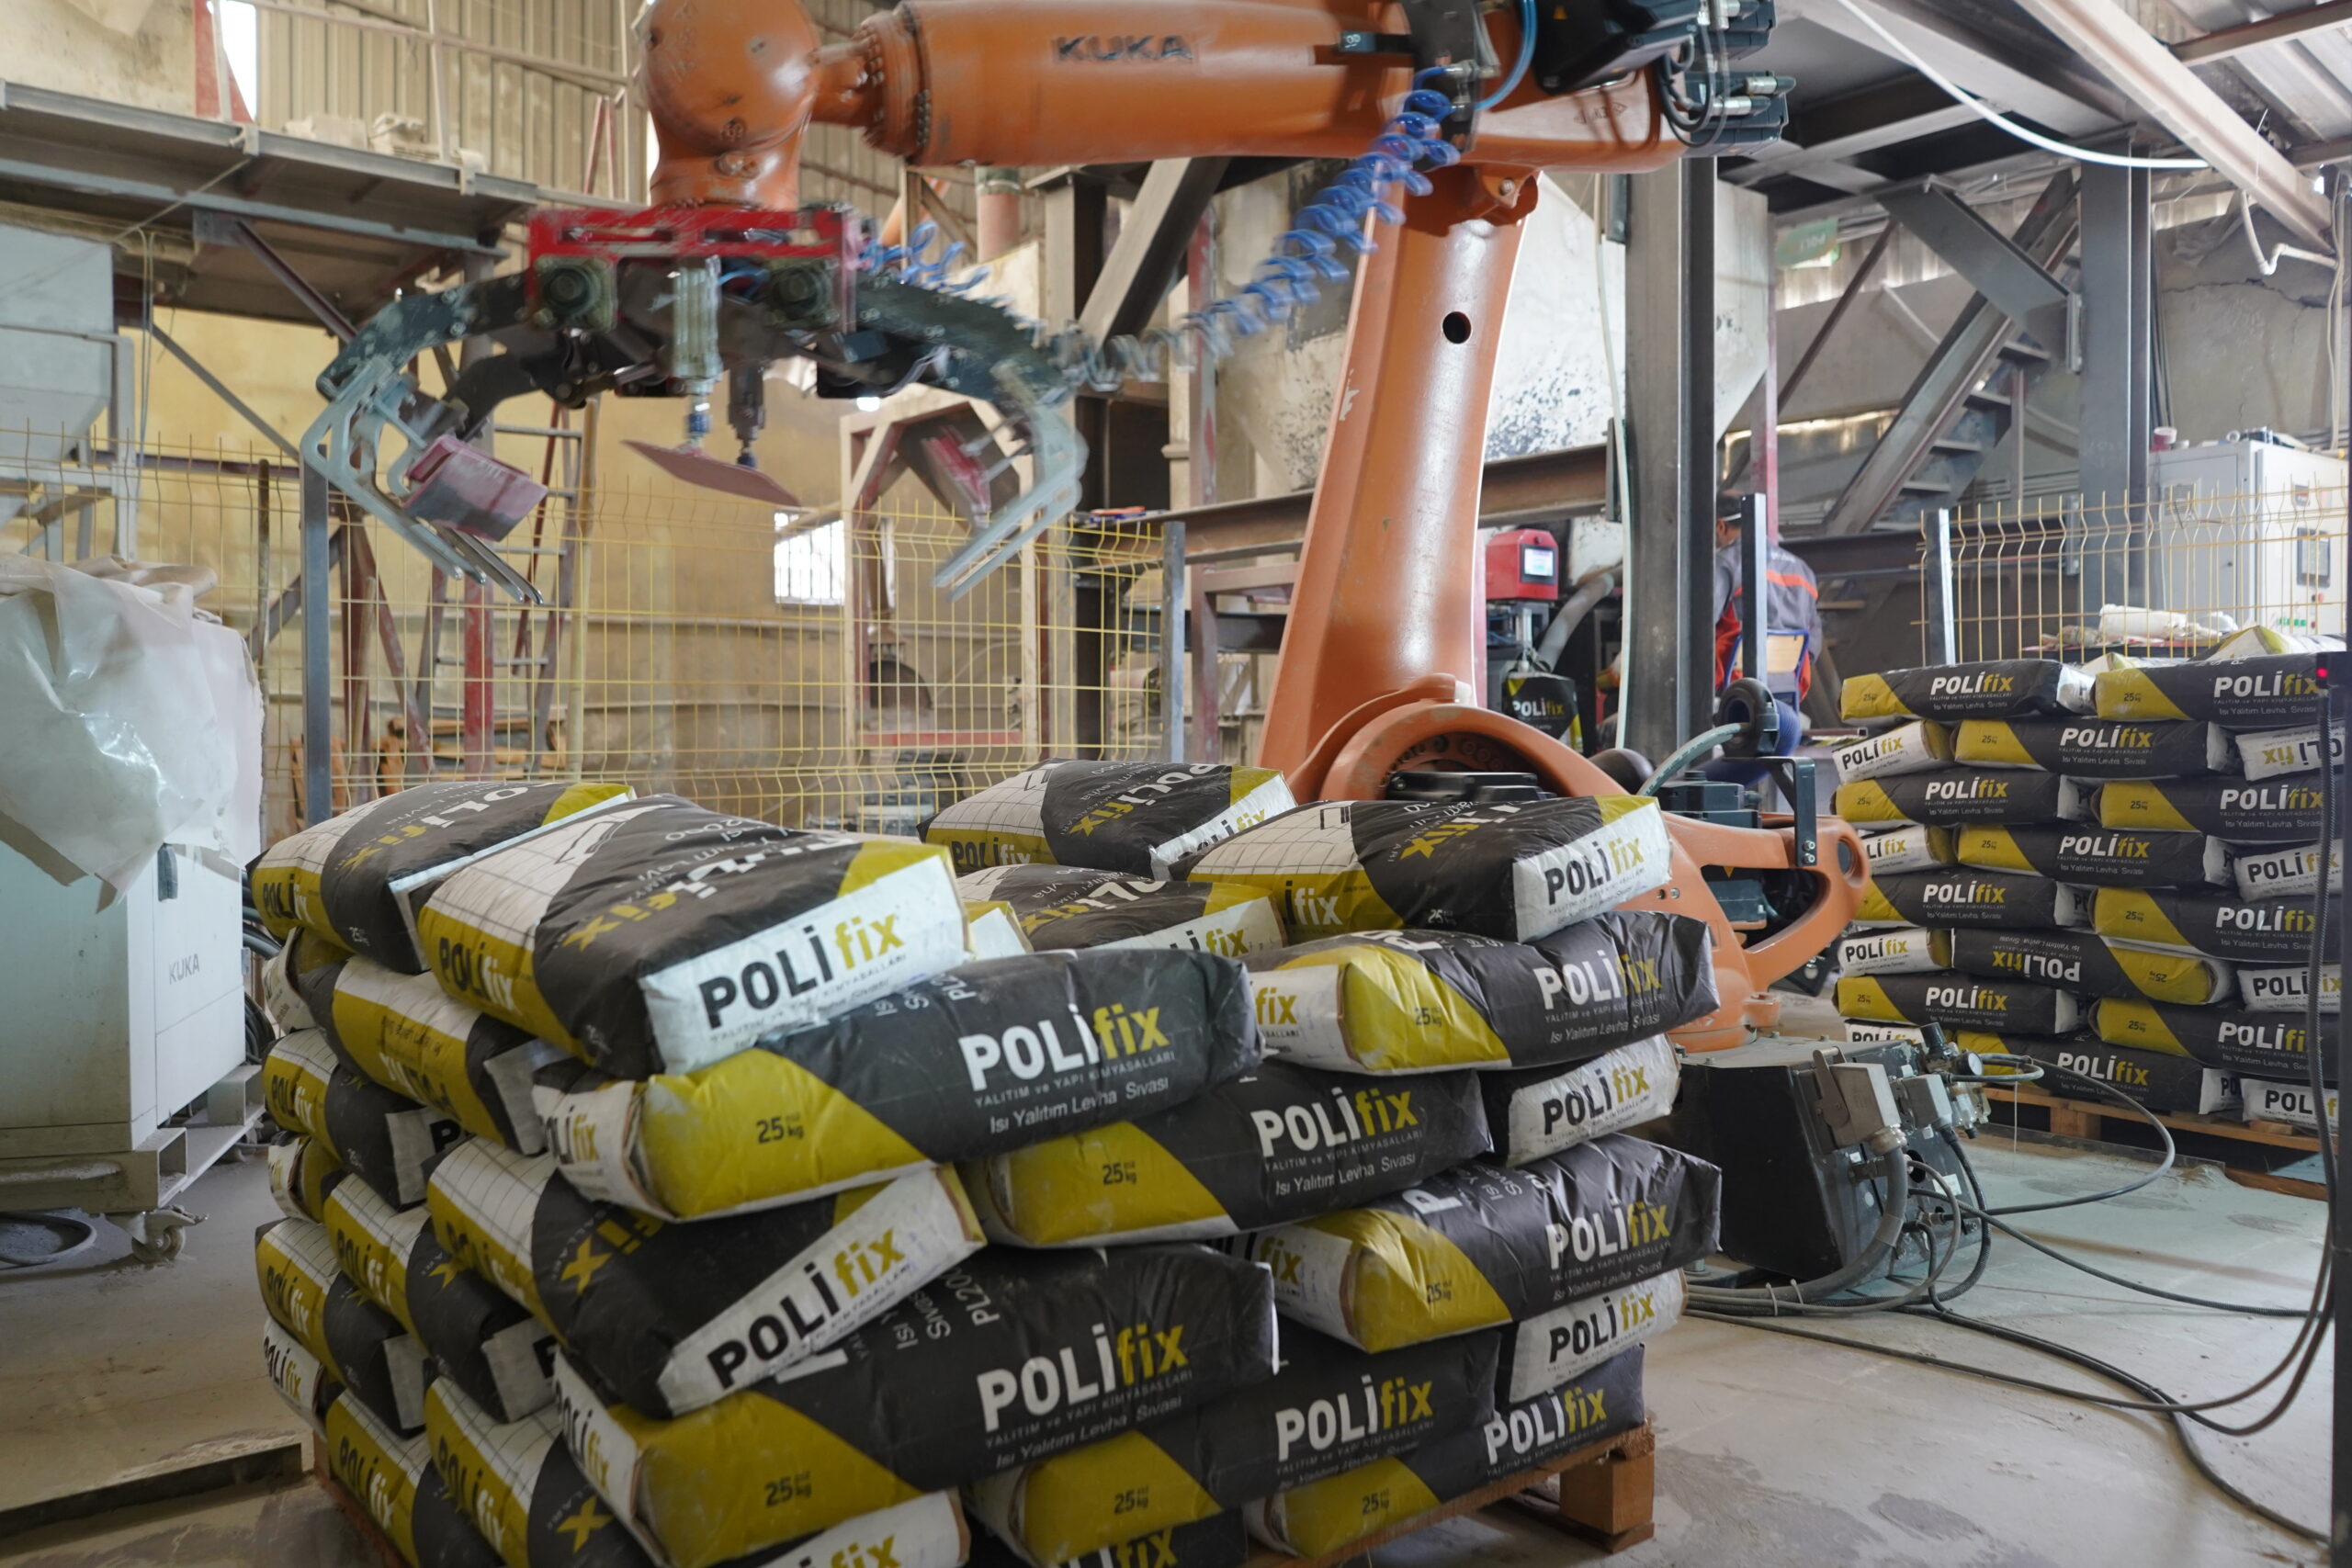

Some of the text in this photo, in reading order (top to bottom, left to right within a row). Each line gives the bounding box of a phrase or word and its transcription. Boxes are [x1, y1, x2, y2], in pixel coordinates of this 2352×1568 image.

[1052, 35, 1193, 62] KUKA
[1868, 838, 1906, 860] Lİfix
[2292, 941, 2312, 950] Sıva
[169, 953, 200, 985] KUKA
[1415, 1007, 1430, 1026] 25
[2218, 1021, 2319, 1053] POLİfi
[975, 1086, 1030, 1108] YALITIM
[1035, 1083, 1050, 1095] ve
[1054, 1075, 1084, 1090] YAPI
[1072, 1089, 1117, 1114] Levha
[756, 1117, 785, 1144] 25
[1102, 1162, 1124, 1185] 25
[1265, 1157, 1307, 1172] YALITIM
[1311, 1156, 1322, 1165] ve
[1326, 1150, 1348, 1161] YAPI
[1338, 1163, 1375, 1184] Levha
[985, 1421, 1041, 1449] YALITIM
[1066, 1404, 1097, 1421] YAPI
[764, 1475, 794, 1508] 25
[1114, 1489, 1136, 1515] 25
[1362, 1493, 1379, 1516] 25
